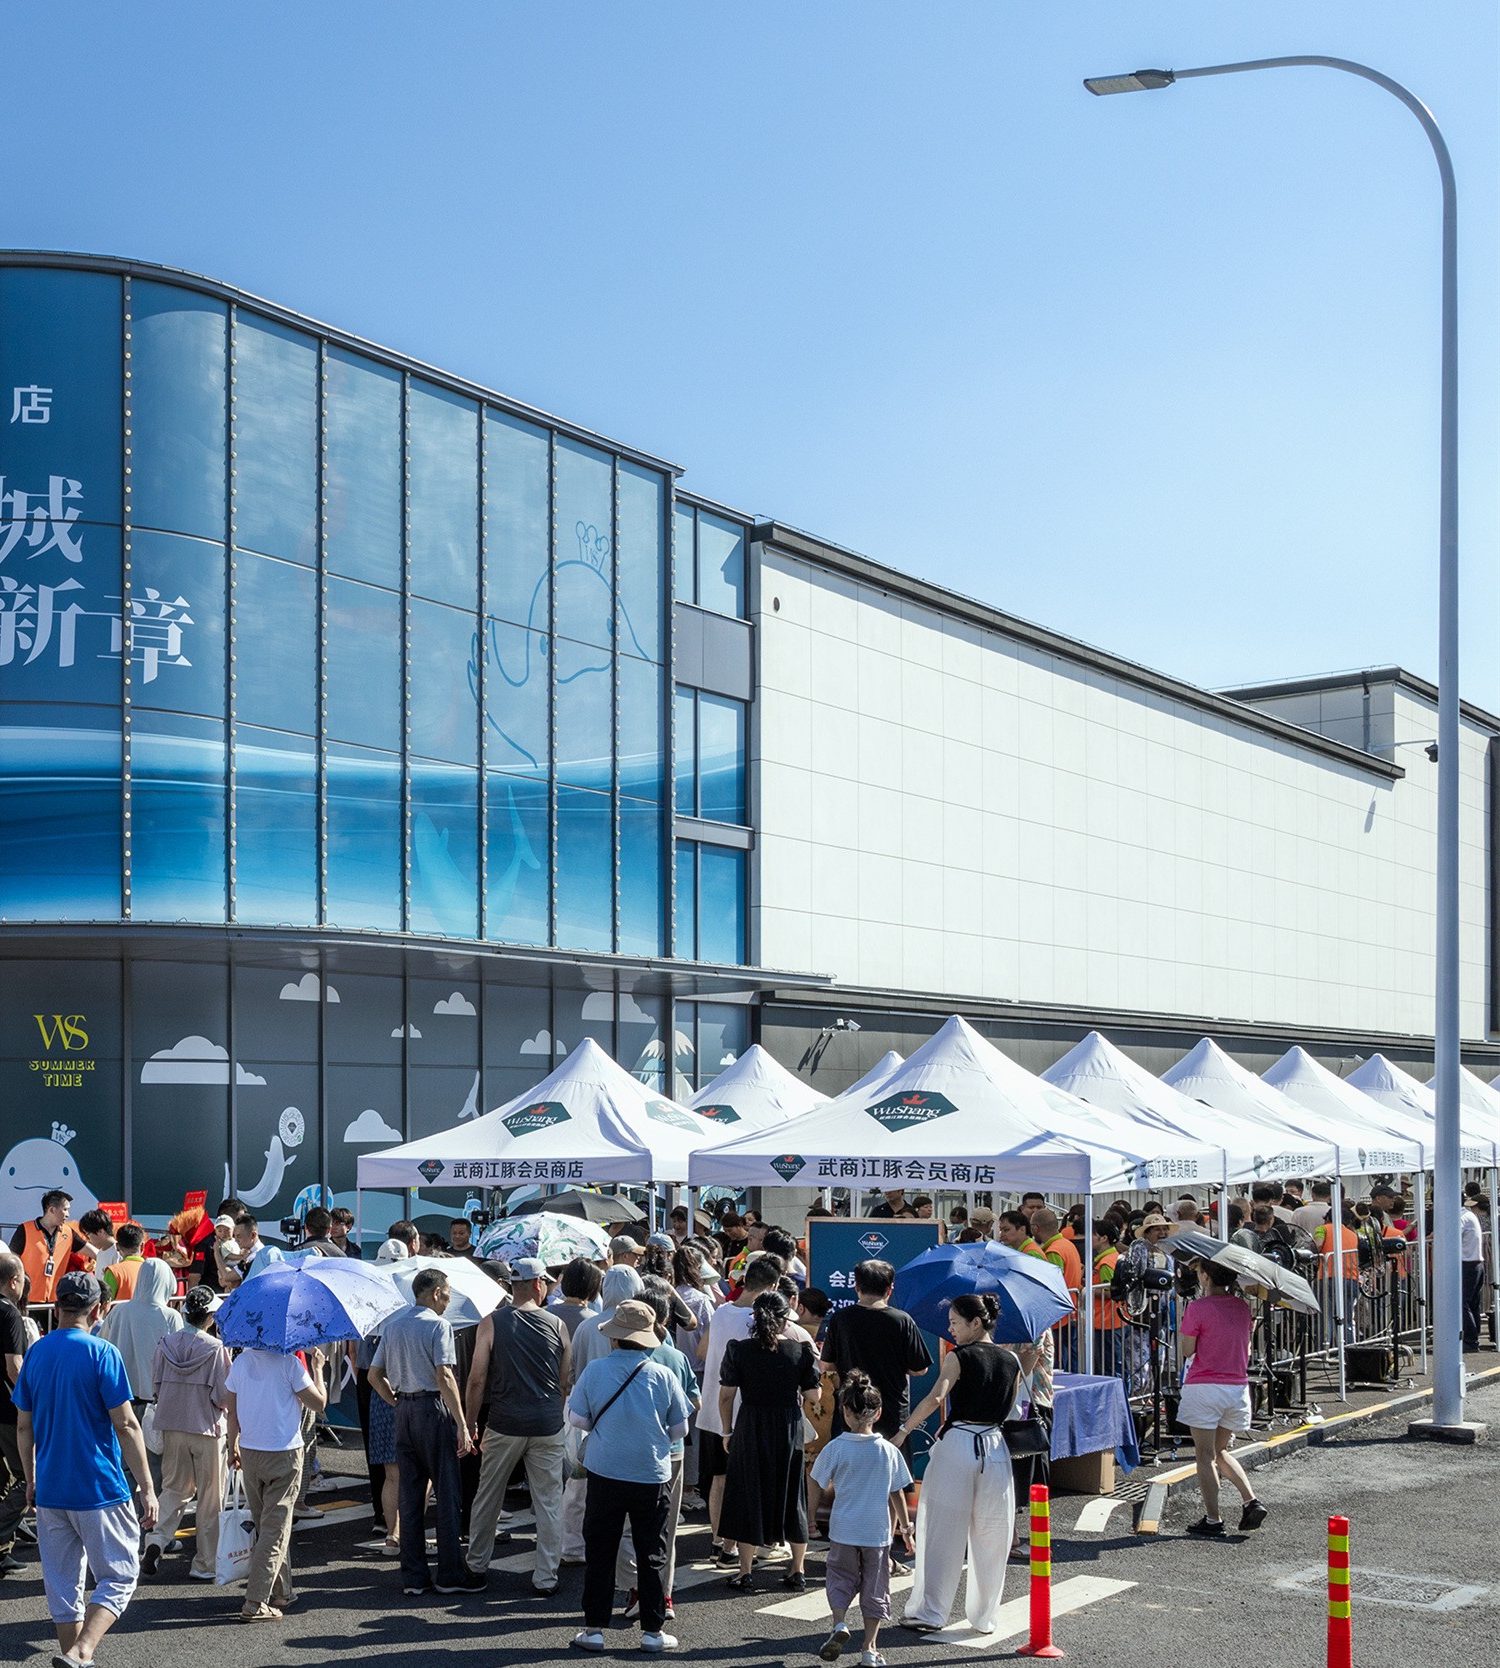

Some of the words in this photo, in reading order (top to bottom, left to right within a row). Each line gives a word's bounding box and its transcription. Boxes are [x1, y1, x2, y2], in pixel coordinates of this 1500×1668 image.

[33, 1014, 89, 1051] WS
[29, 1060, 96, 1071] SUMMER
[43, 1073, 82, 1087] TIME
[873, 1105, 941, 1118] WuShang
[453, 1160, 584, 1179] 武商江豚会员商店
[817, 1157, 996, 1184] 武商江豚会员商店
